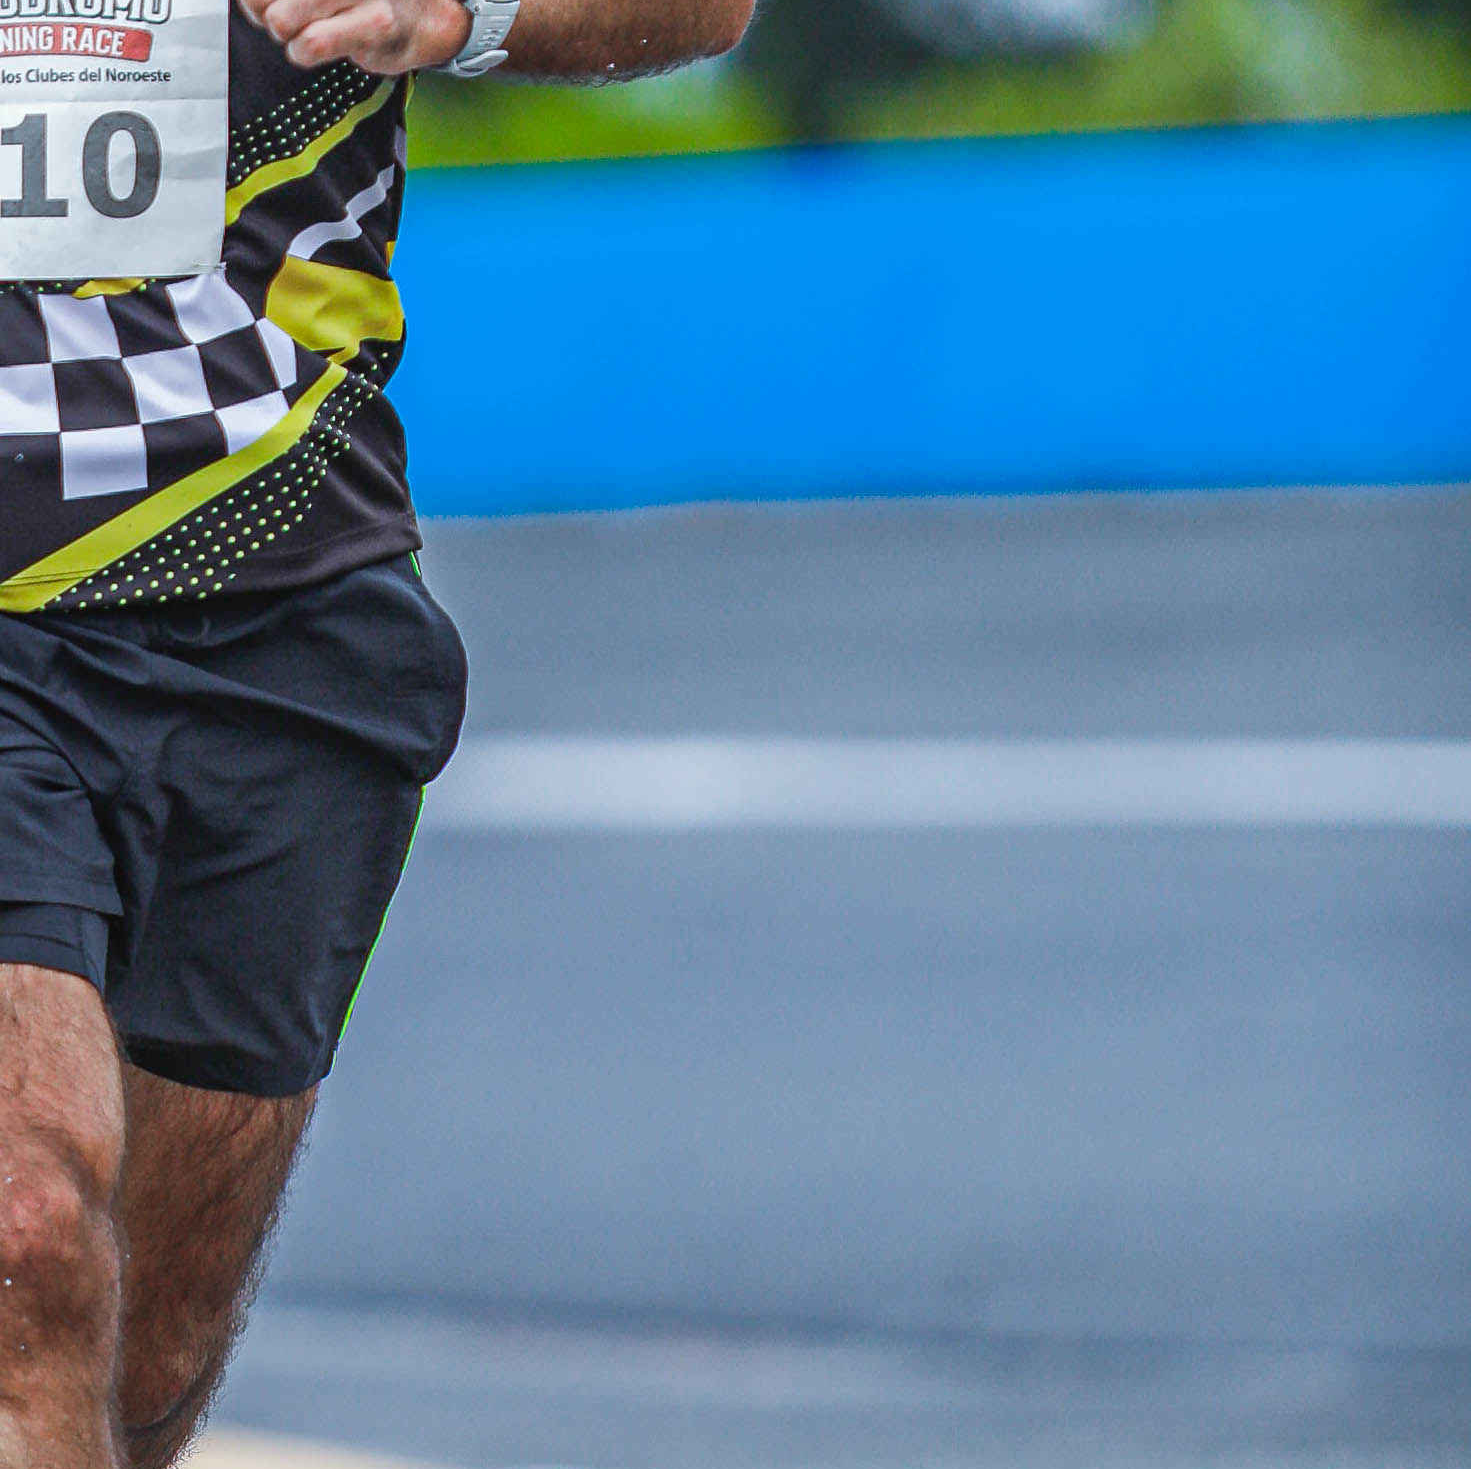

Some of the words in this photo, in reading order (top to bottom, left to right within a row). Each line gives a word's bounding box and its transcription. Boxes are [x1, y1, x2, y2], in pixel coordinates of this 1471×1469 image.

[61, 26, 126, 57] RACE
[1, 69, 22, 84] los
[26, 68, 75, 83] Clubes
[79, 67, 102, 82] del
[106, 67, 172, 82] Noroeste
